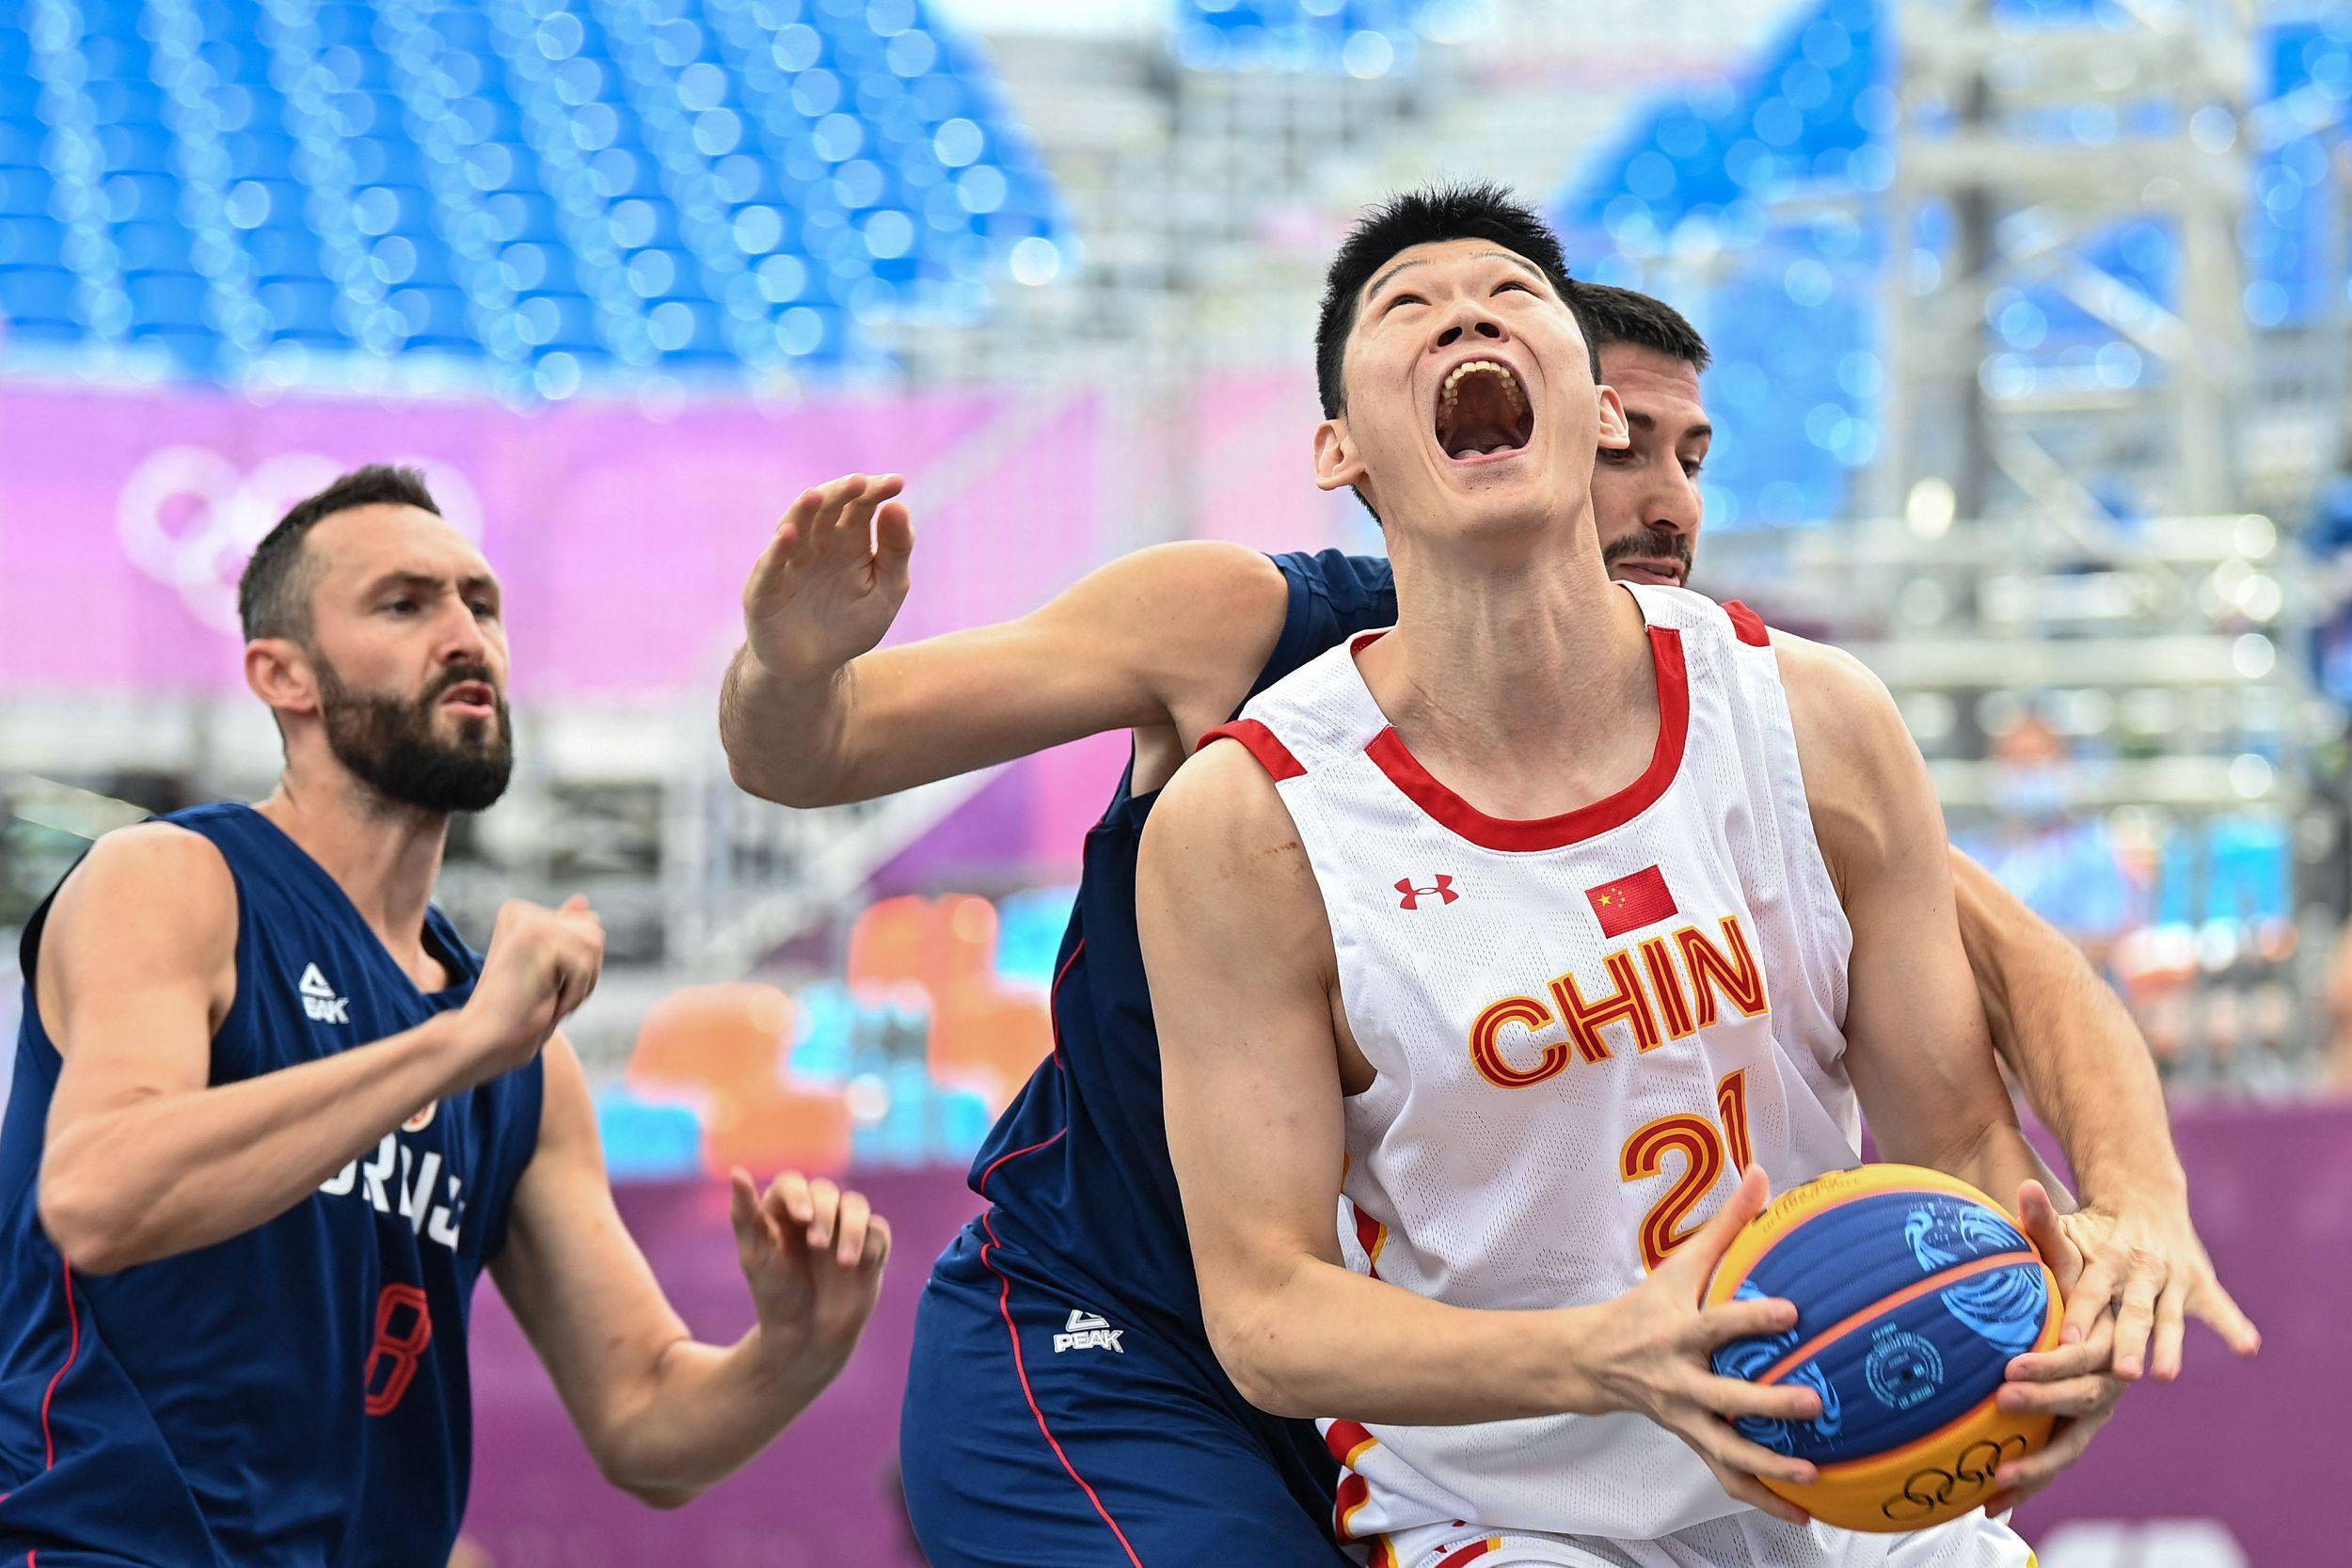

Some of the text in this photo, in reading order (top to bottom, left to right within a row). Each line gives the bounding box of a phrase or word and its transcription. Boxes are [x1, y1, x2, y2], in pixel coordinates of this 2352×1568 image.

[301, 995, 350, 1024] EAK
[1470, 914, 1770, 1089] CHIN
[1619, 1068, 1754, 1273] 21
[365, 1283, 432, 1416] 8
[1053, 1329, 1124, 1354] PEAK
